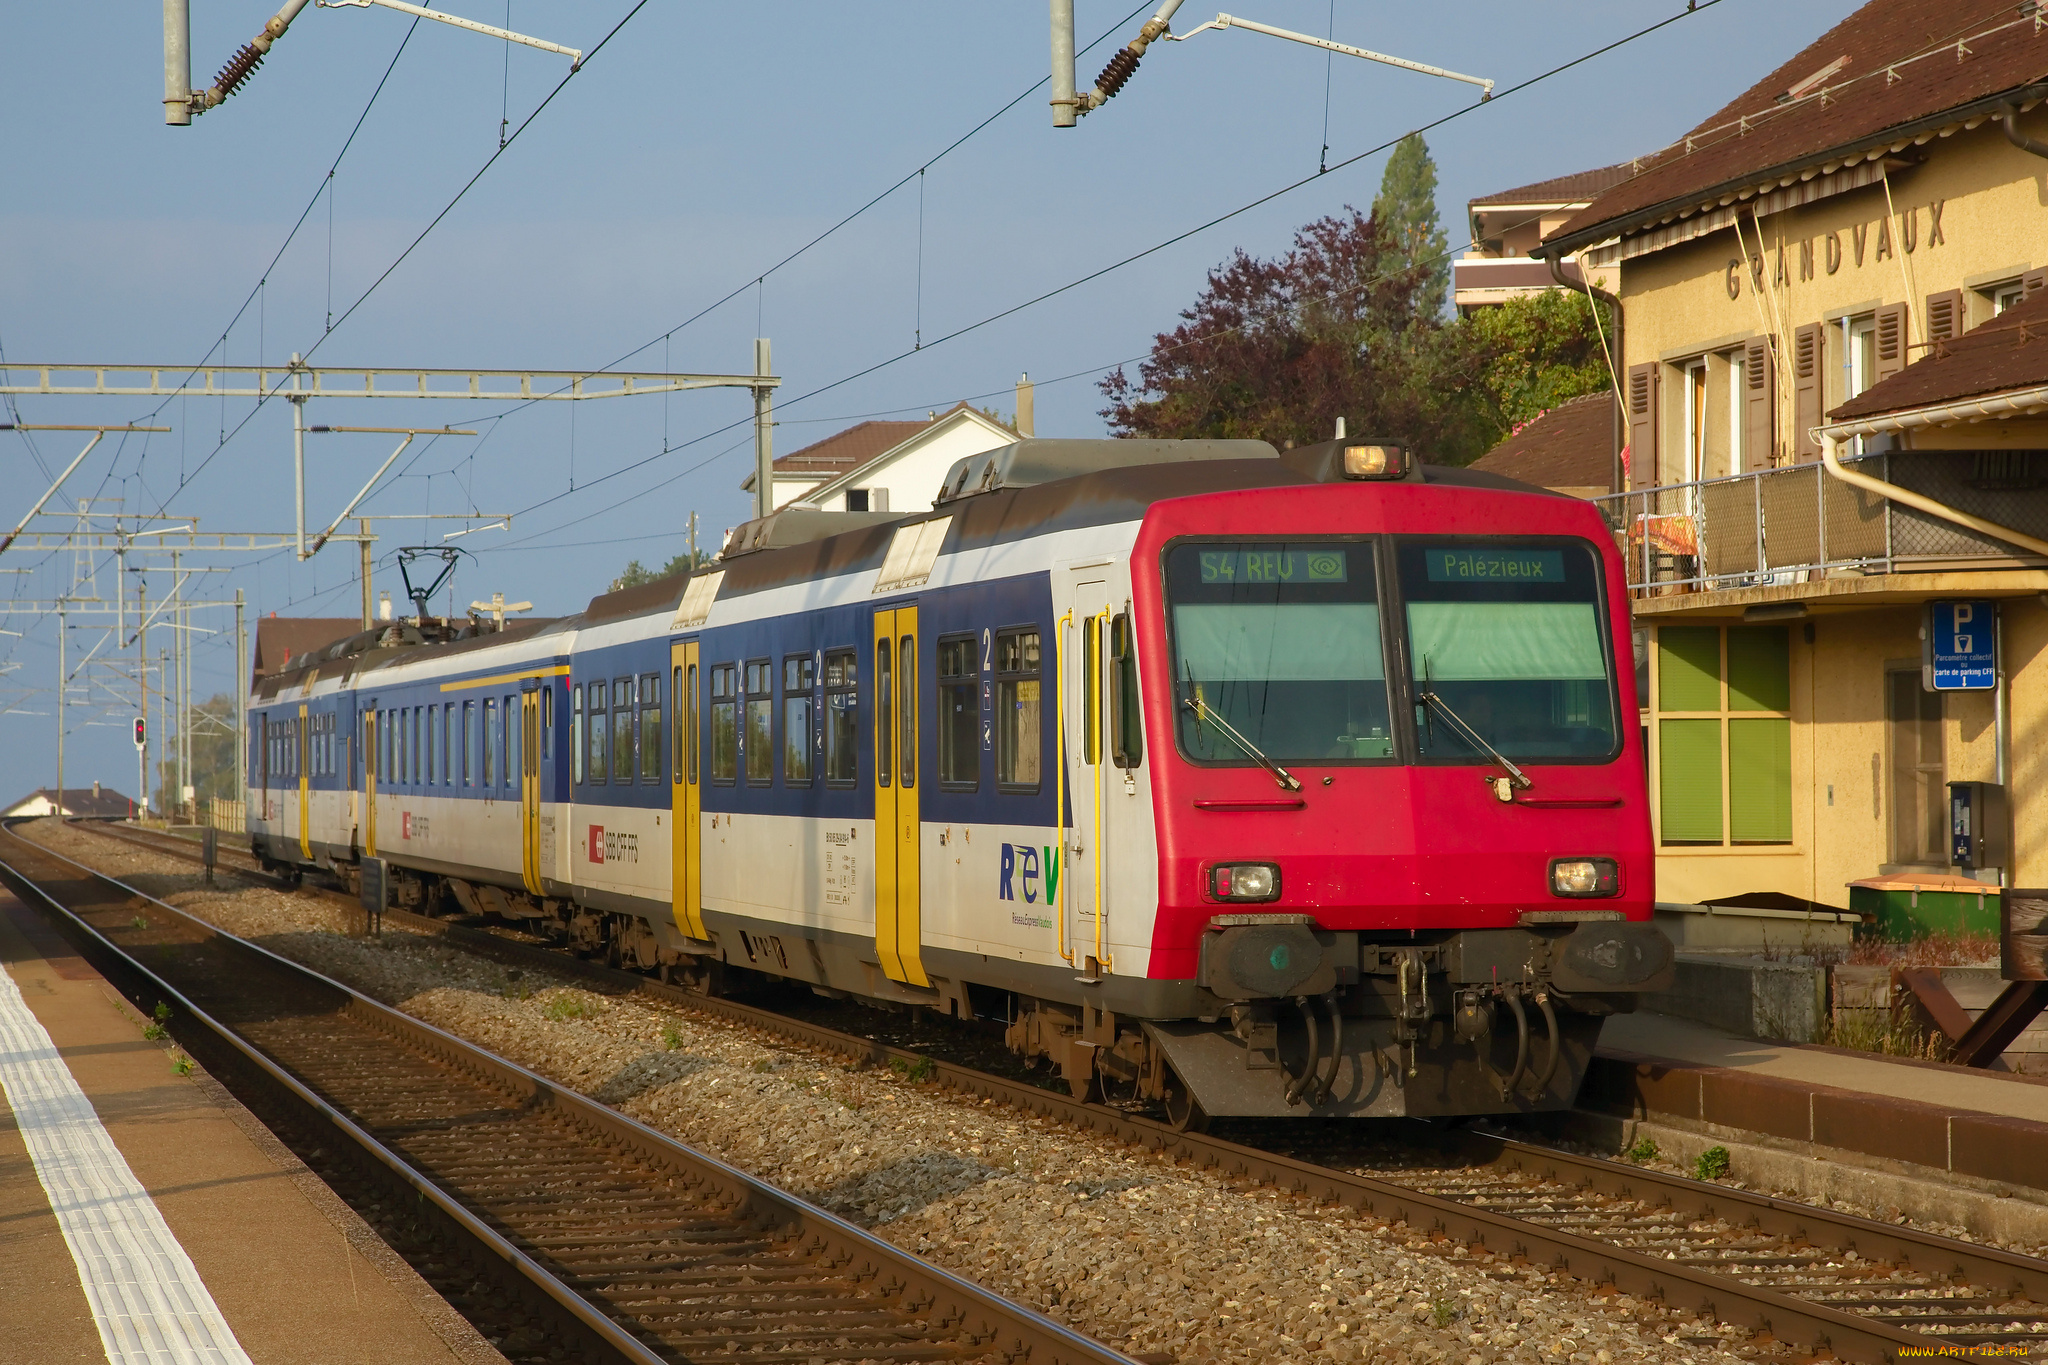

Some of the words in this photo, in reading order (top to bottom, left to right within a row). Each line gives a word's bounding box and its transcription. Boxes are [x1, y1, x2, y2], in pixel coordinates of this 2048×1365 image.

[1726, 199, 1945, 300] GRANDVAUX
[1202, 552, 1234, 581] S4
[1445, 554, 1544, 577] Palézieux
[1954, 604, 1972, 633] P
[983, 627, 991, 671] 2
[1969, 653, 1992, 661] collectif
[738, 659, 743, 693] 2
[815, 649, 822, 686] 2
[1960, 668, 1981, 677] parking
[634, 673, 639, 703] 2
[605, 831, 616, 860] SBB
[628, 833, 639, 864] FFS
